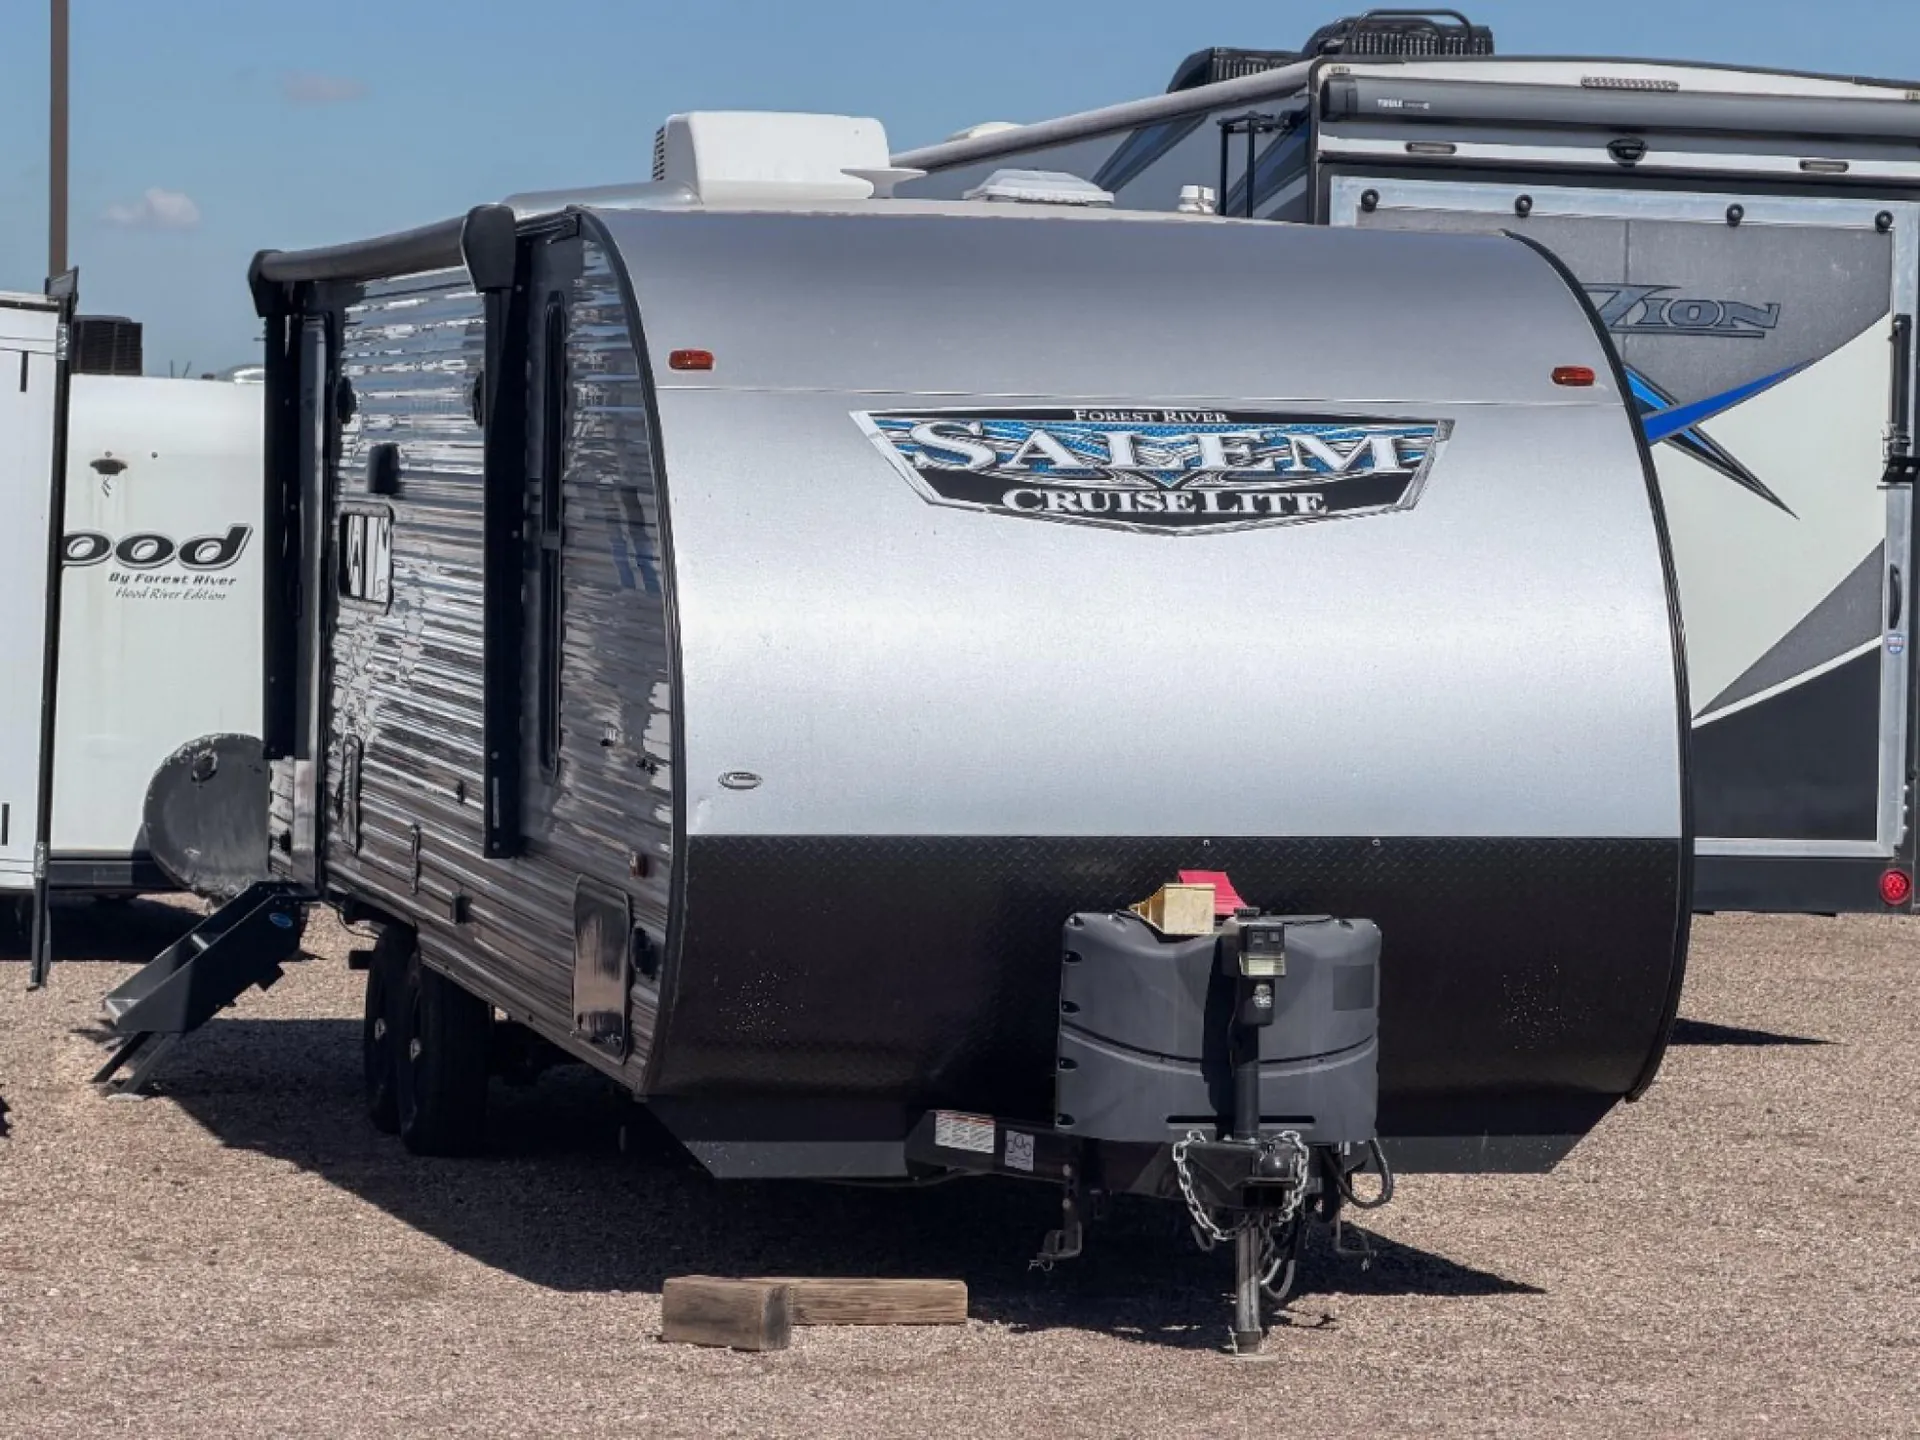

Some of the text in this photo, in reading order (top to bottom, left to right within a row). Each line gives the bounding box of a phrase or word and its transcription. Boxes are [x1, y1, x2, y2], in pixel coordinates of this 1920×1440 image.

[1073, 409, 1229, 423] FOREST RIVER
[909, 420, 1408, 471] SALEM
[108, 572, 236, 585] By Forest River
[149, 588, 182, 600] River
[183, 588, 226, 600] Edition
